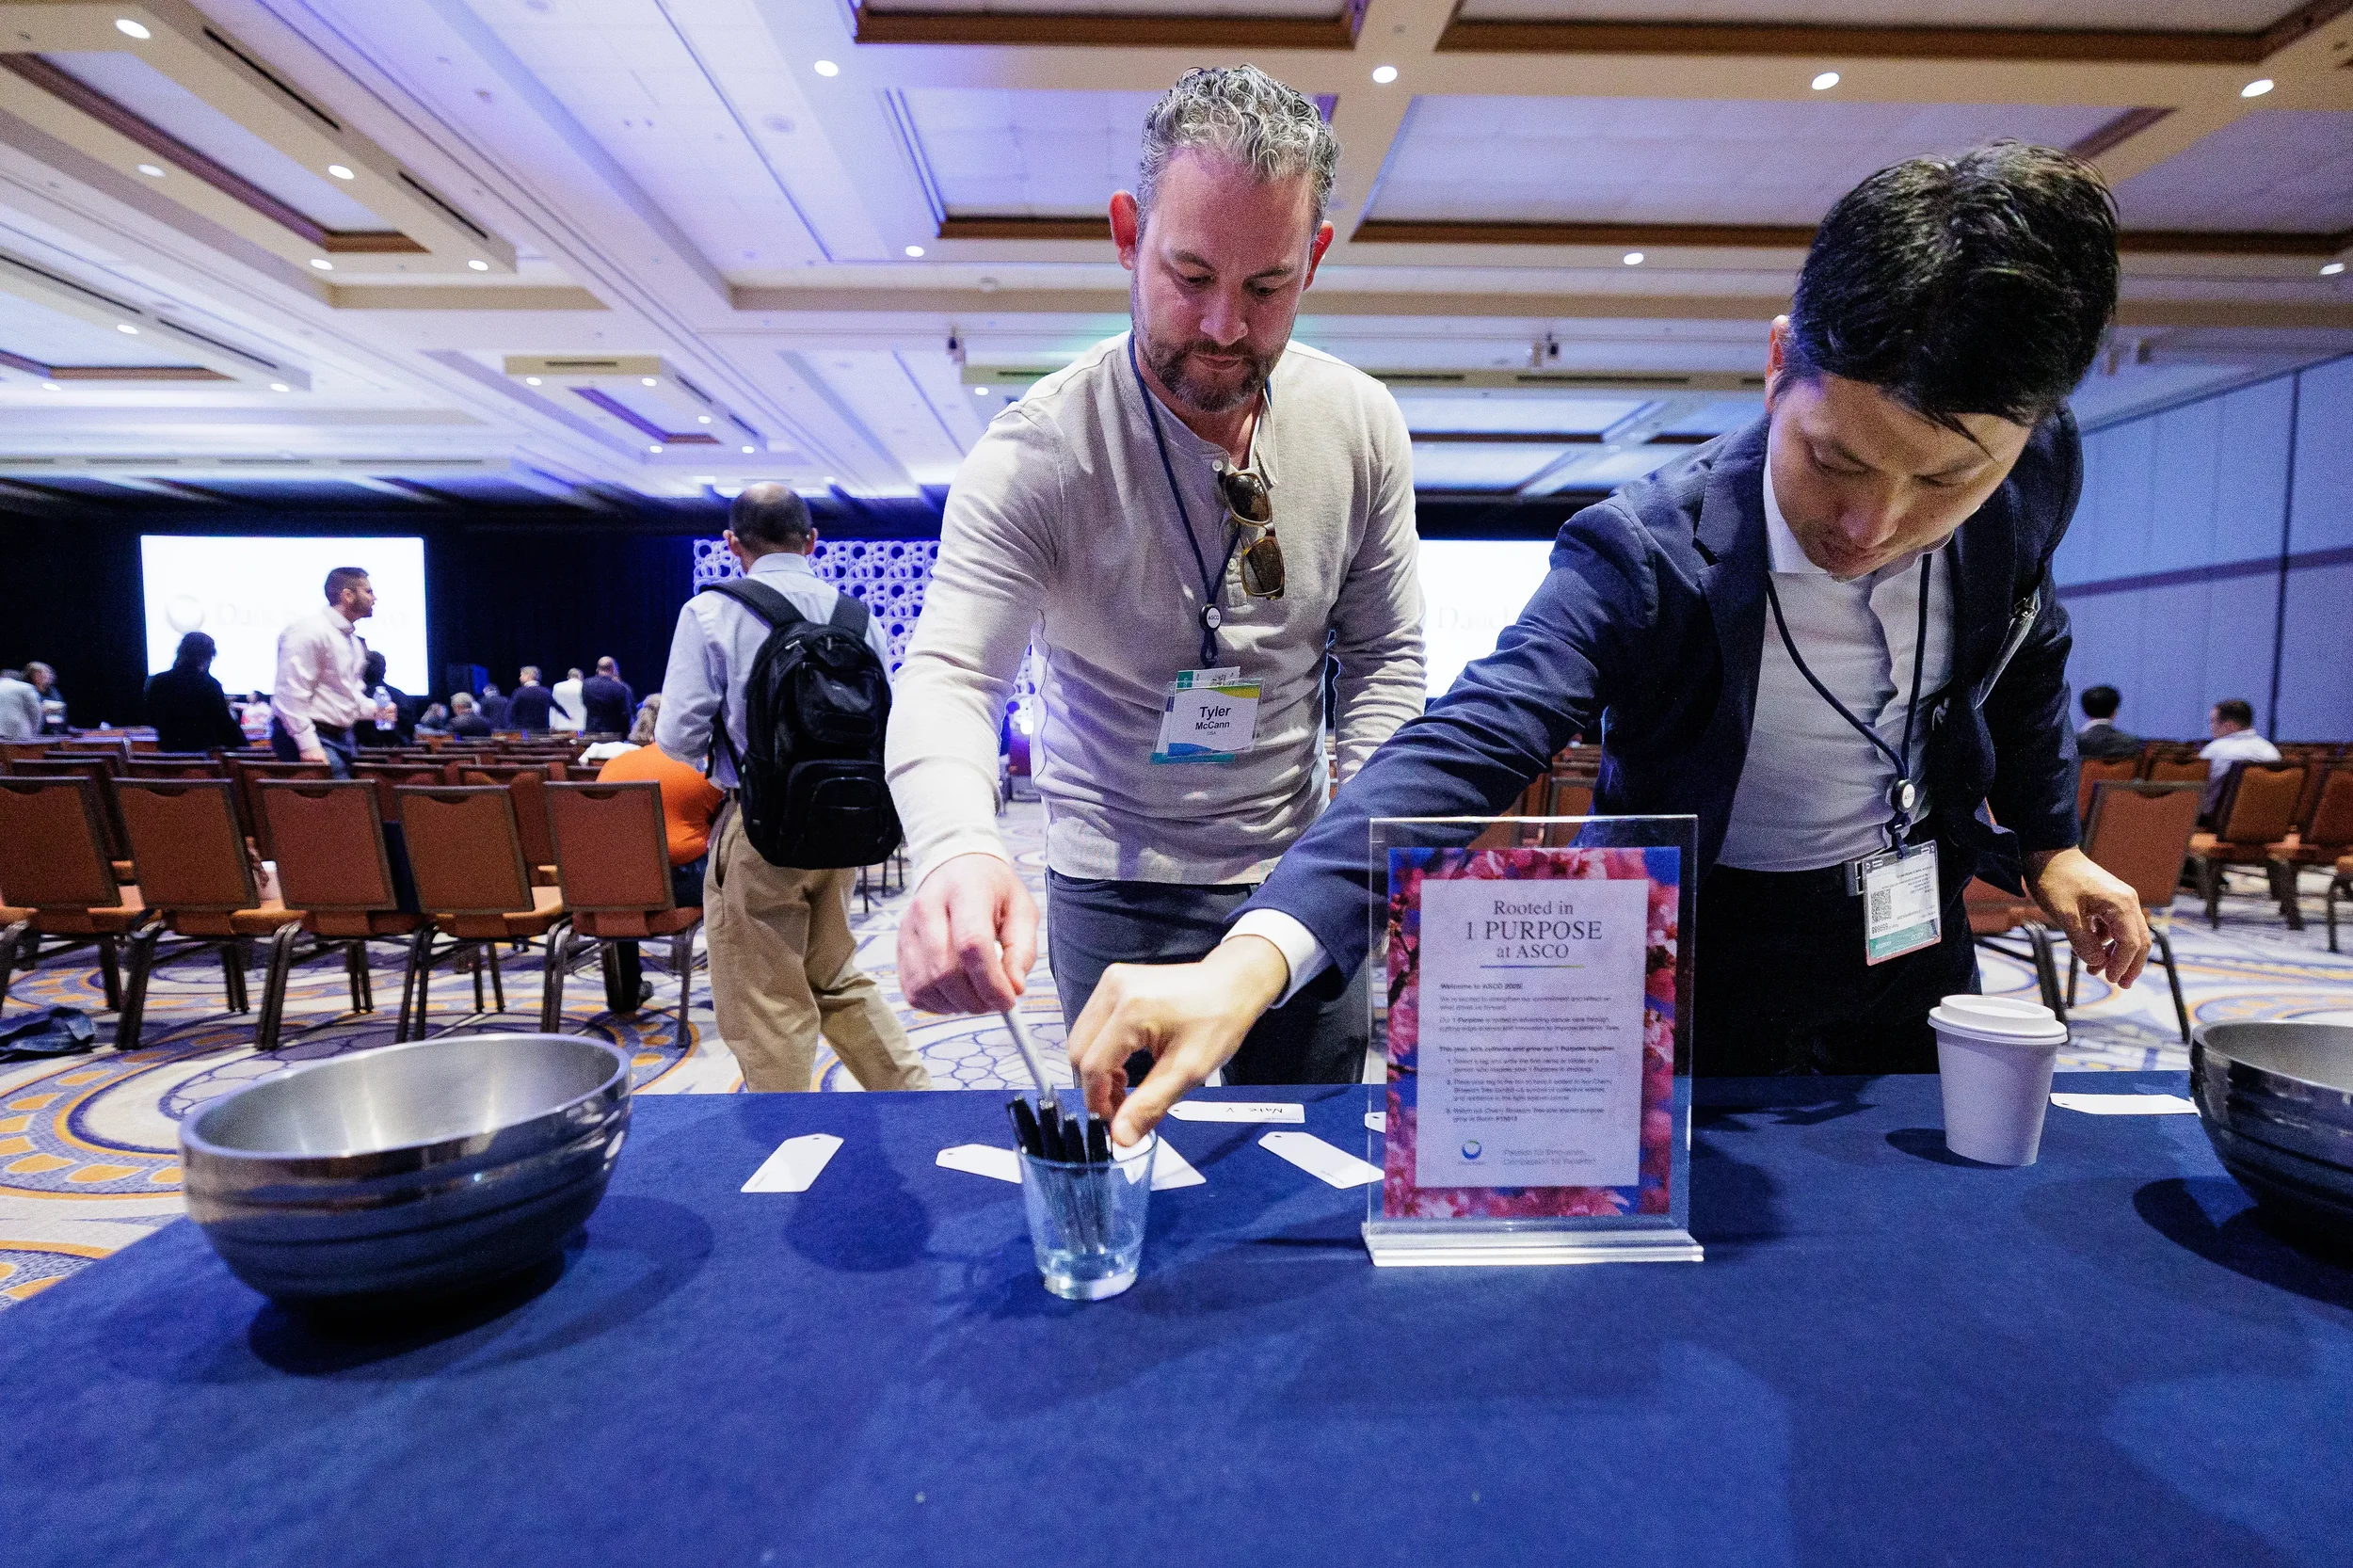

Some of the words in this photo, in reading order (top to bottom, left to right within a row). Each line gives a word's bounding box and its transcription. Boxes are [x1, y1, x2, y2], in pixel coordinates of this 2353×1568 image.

[1199, 705, 1232, 721] Tyler
[1194, 721, 1230, 730] McCann
[1494, 900, 1552, 915] Rooted
[1559, 900, 1574, 915] in
[1485, 920, 1603, 940] PURPOSE
[1497, 946, 1511, 958] at
[1516, 943, 1569, 959] ASCO
